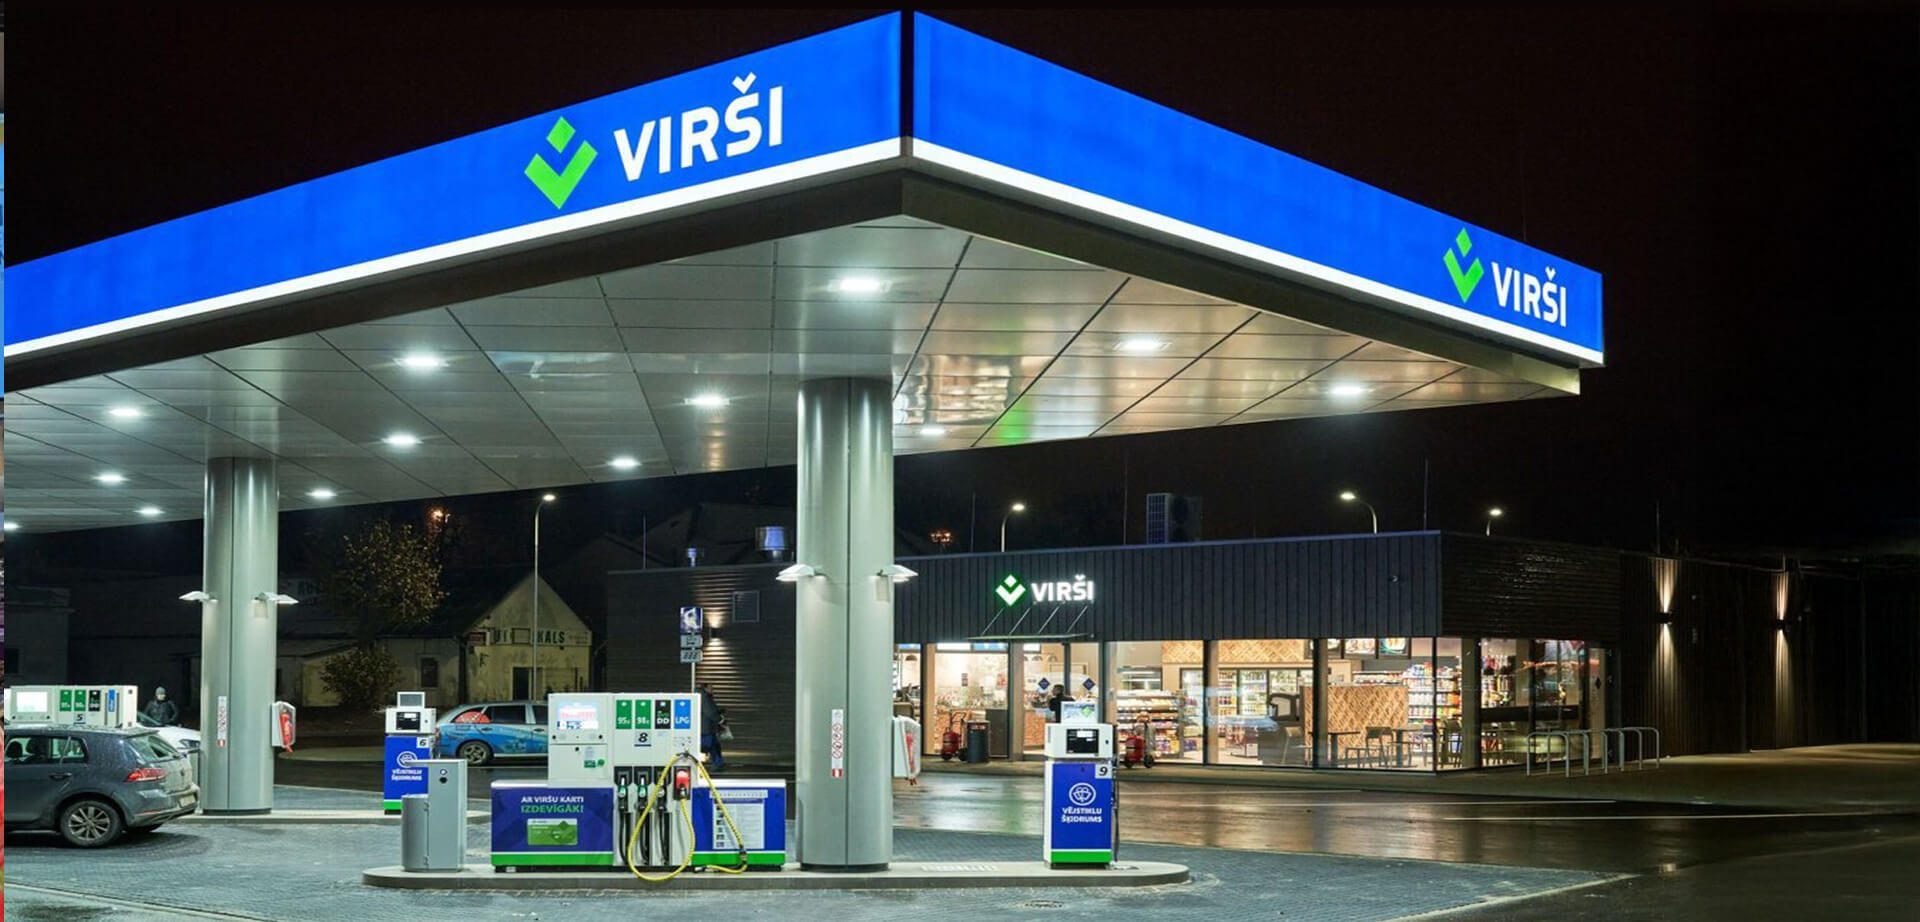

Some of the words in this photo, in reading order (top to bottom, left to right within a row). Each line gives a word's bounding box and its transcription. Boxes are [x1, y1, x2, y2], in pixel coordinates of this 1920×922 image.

[613, 72, 783, 182] VIRŠI
[1491, 266, 1566, 327] VIRŠI
[1031, 574, 1094, 602] VIRŠI
[656, 717, 670, 725] DD
[674, 716, 690, 724] LPG
[419, 738, 427, 747] 6
[638, 732, 649, 743] 8
[1098, 766, 1108, 777] 9
[534, 795, 558, 803] VIRŠU
[1061, 806, 1103, 815] VĒJSTIKLU
